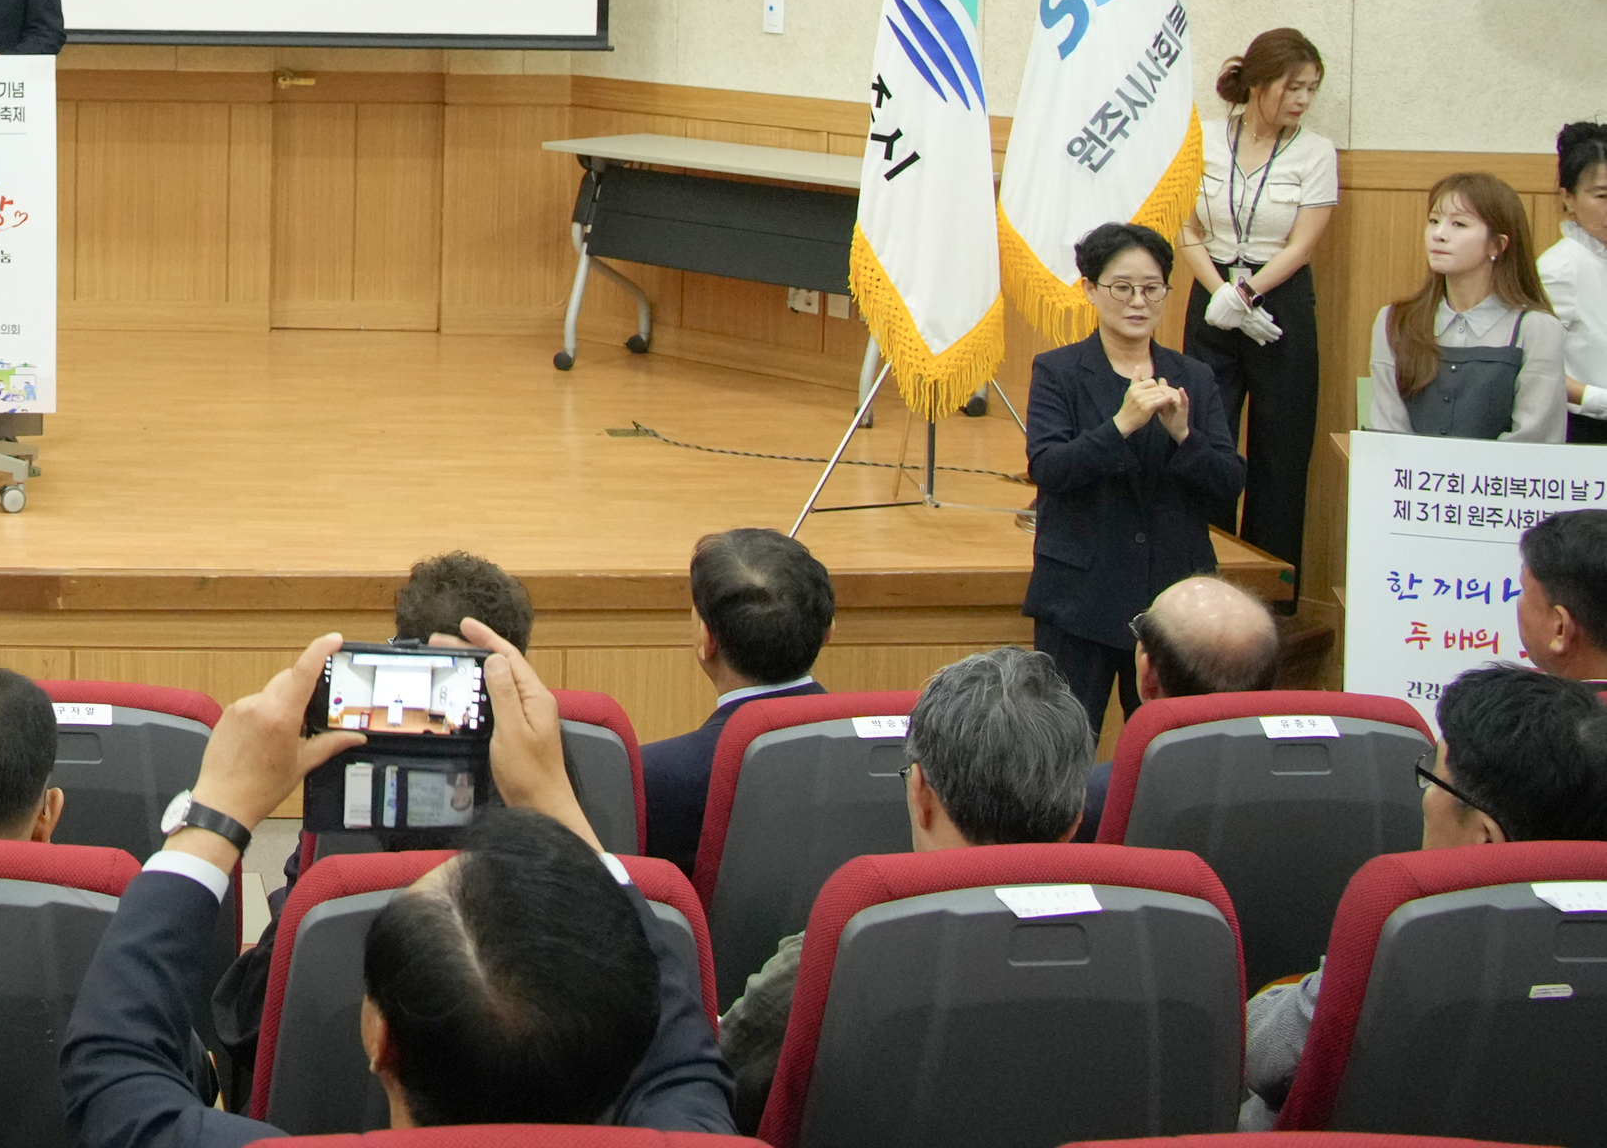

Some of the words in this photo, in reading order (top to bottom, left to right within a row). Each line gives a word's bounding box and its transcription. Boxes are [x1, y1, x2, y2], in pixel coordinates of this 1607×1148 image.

[0, 80, 25, 99] 기념
[1393, 468, 1412, 491] 제
[1418, 471, 1464, 495] 27회
[1471, 475, 1564, 501] 사회복지의
[1571, 480, 1589, 502] 날
[1393, 500, 1411, 522] 제
[1417, 503, 1461, 525] 31회
[1386, 572, 1423, 600] 한
[1433, 576, 1490, 604] 끼의
[1405, 621, 1432, 650] 두
[1444, 628, 1499, 654] 배의
